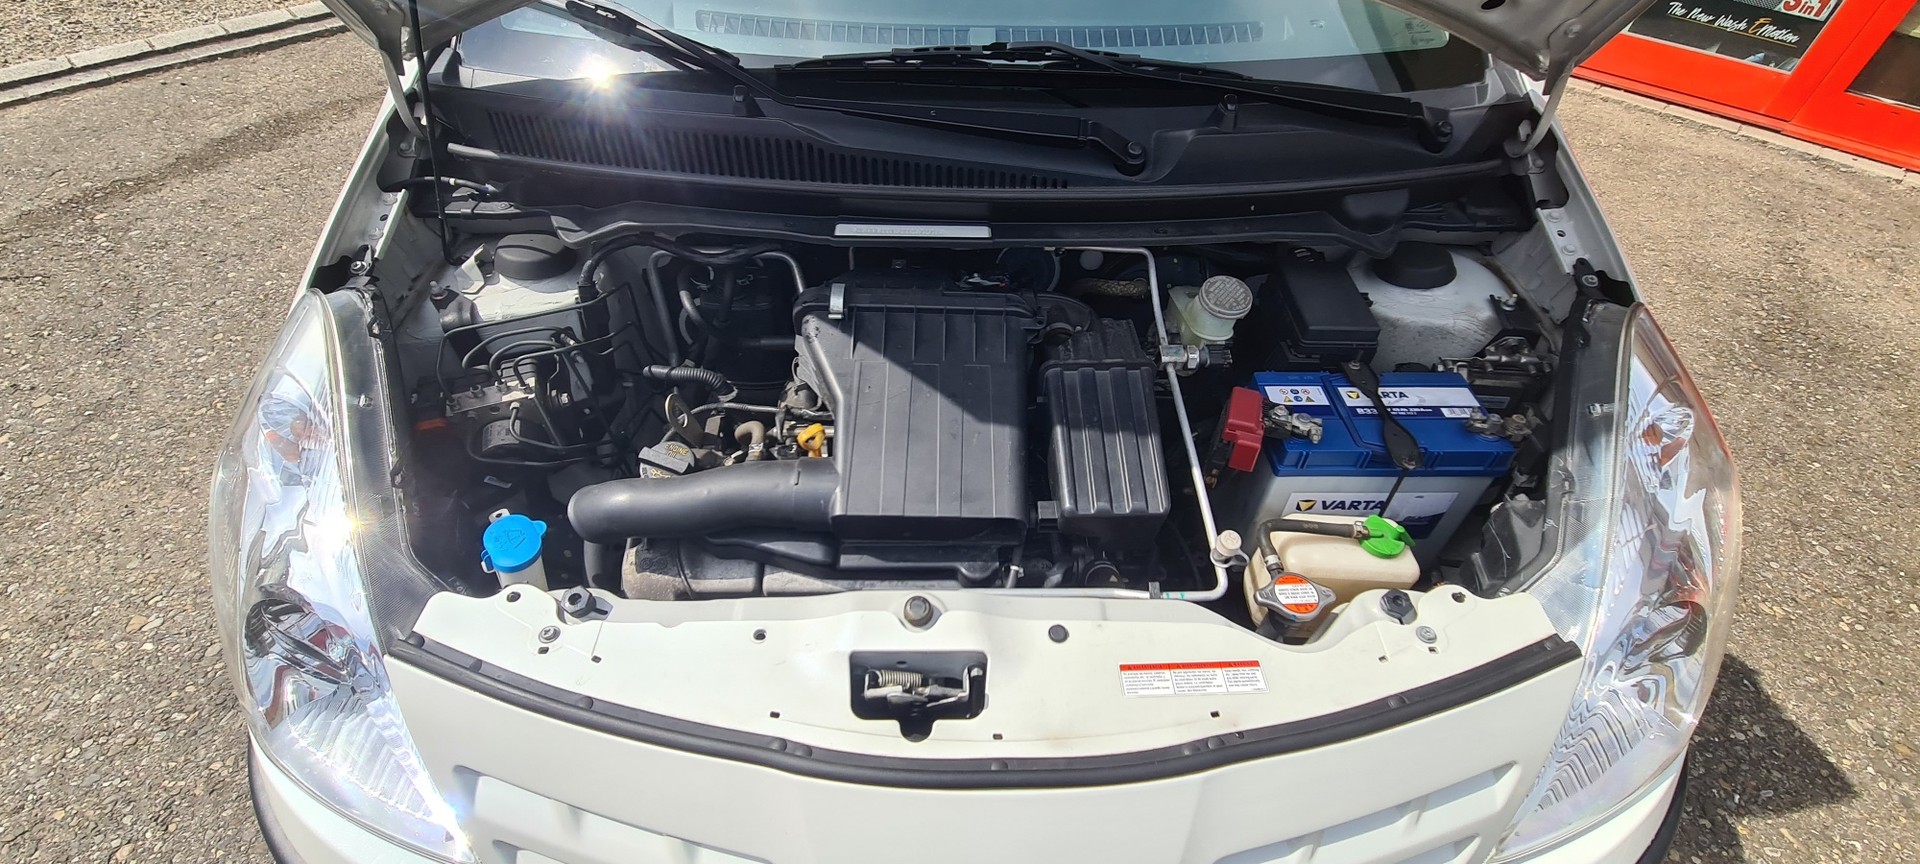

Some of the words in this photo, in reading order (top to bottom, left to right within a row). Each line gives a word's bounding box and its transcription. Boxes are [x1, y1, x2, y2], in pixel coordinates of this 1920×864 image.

[1667, 2, 1688, 16] The
[1687, 7, 1716, 22] New
[1714, 15, 1748, 31] Wash
[665, 444, 689, 456] ENGINE
[1321, 500, 1386, 511] VARTA
